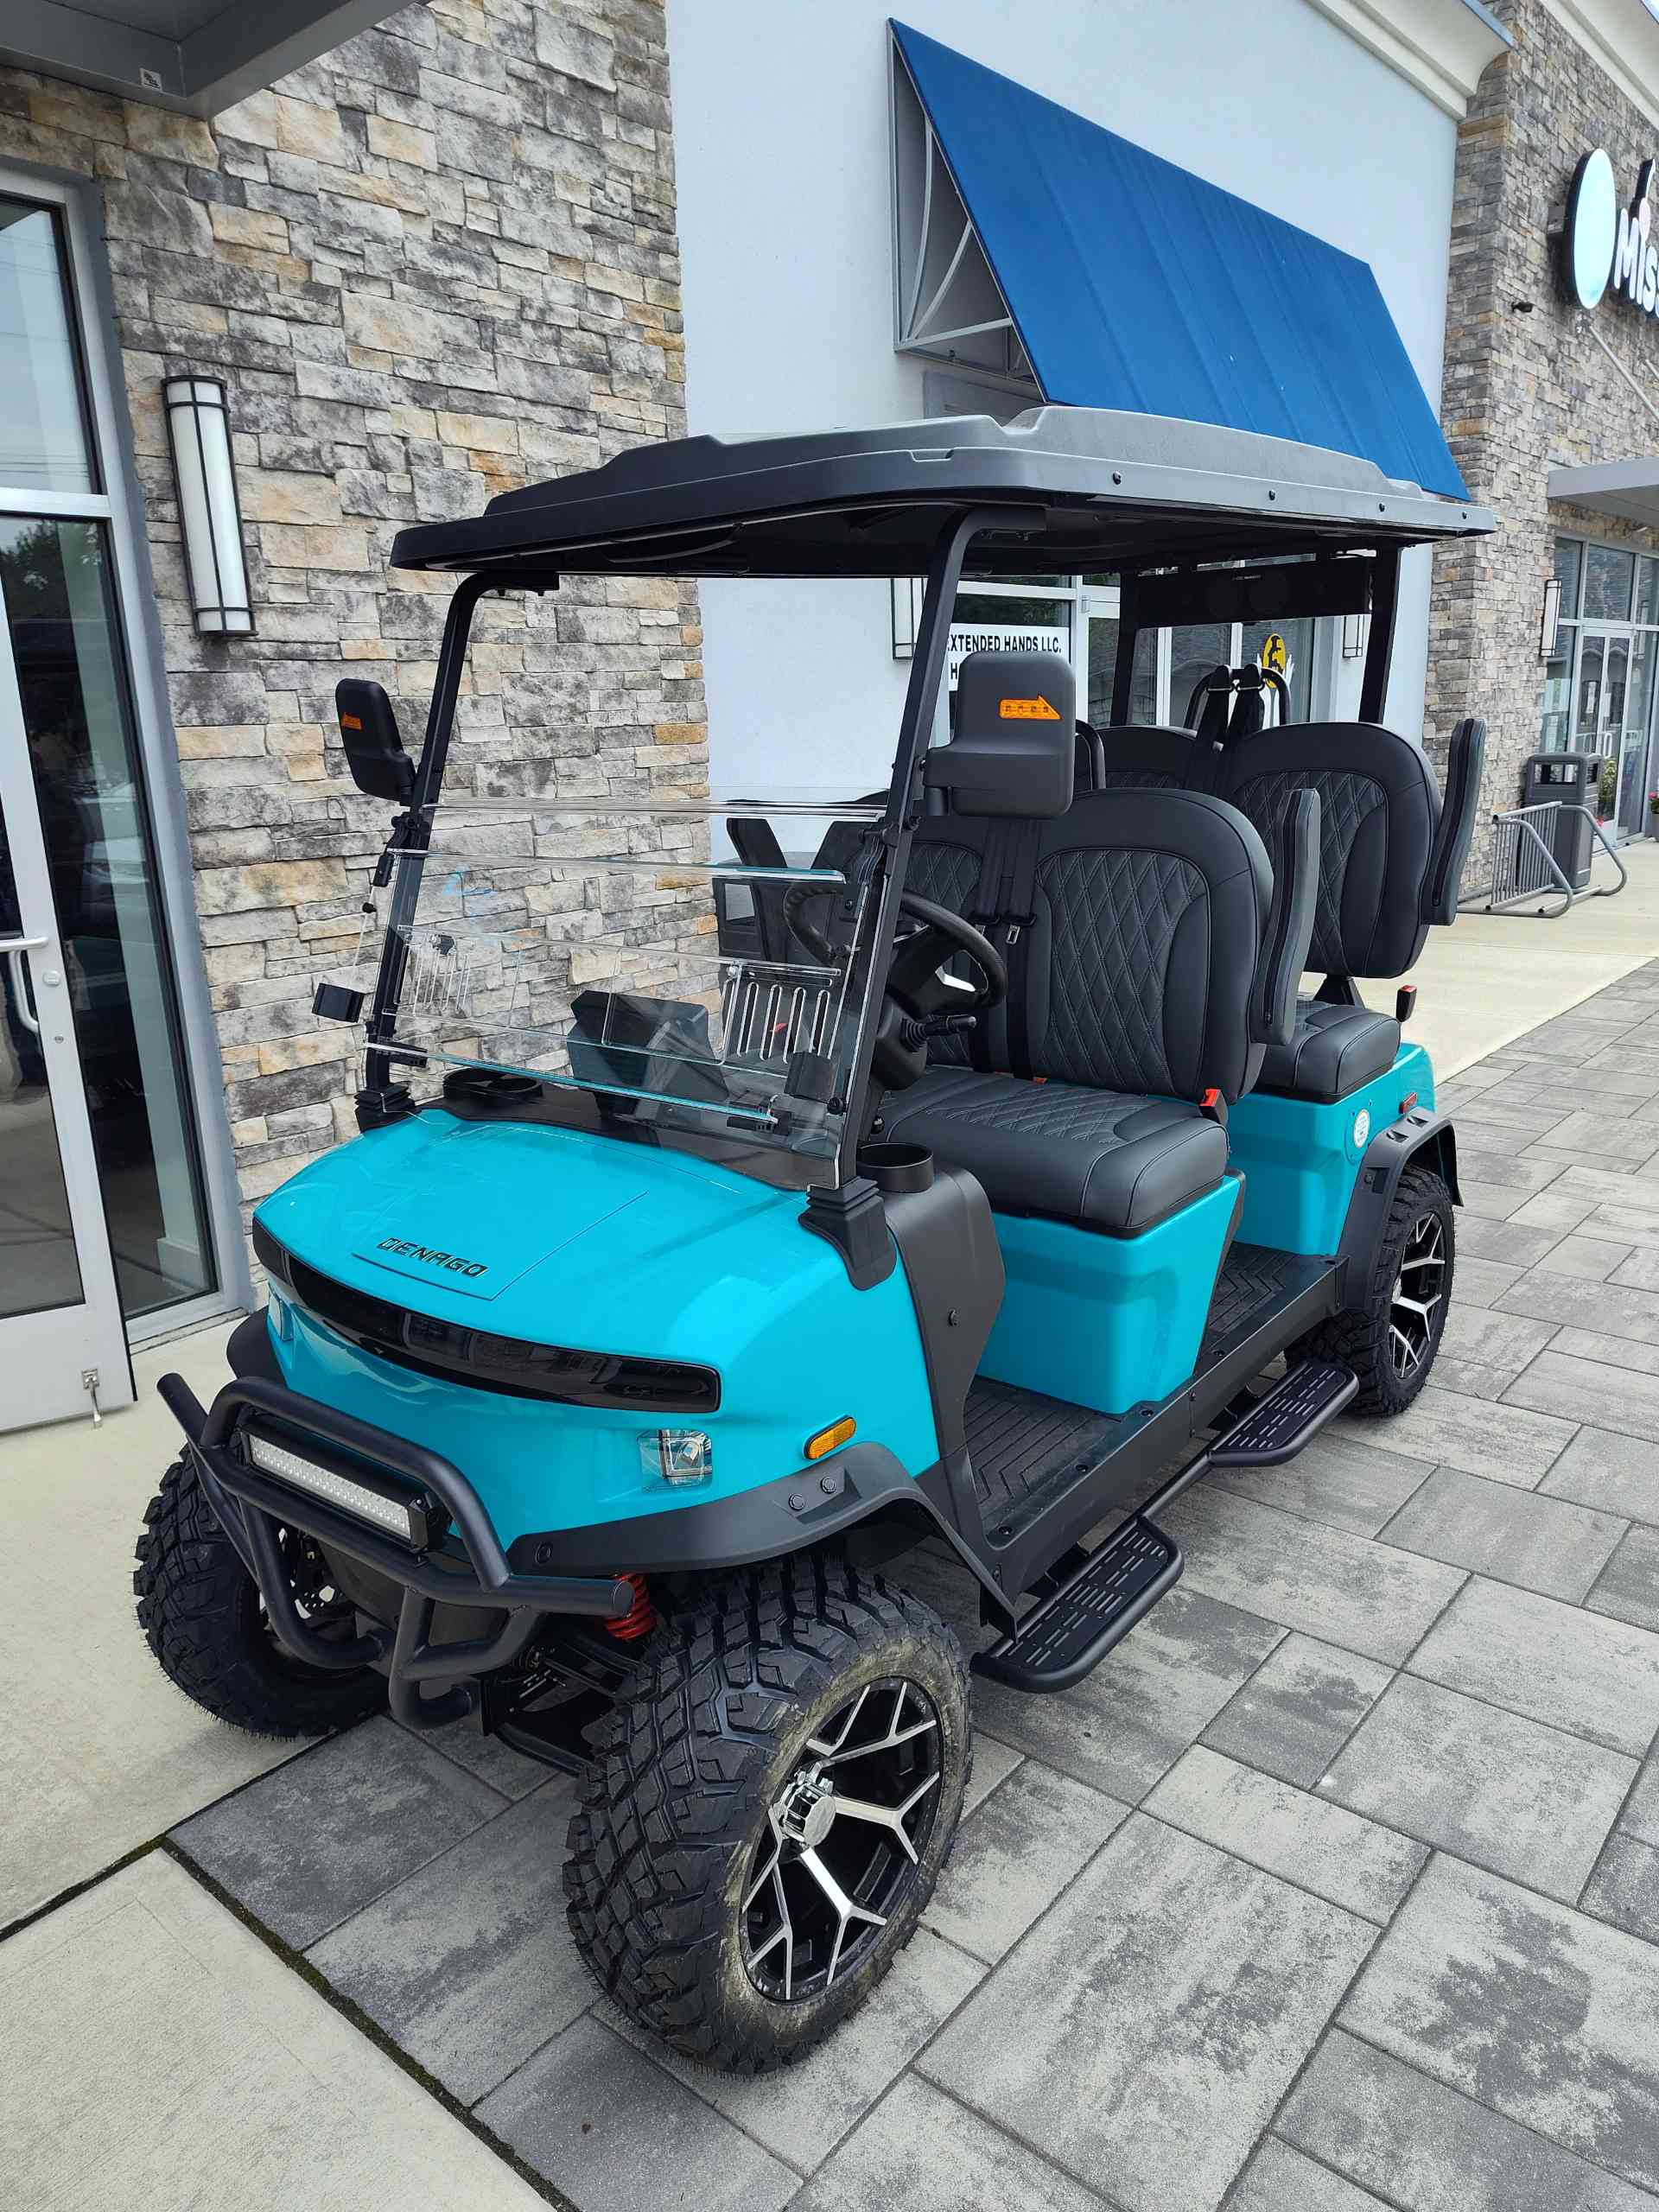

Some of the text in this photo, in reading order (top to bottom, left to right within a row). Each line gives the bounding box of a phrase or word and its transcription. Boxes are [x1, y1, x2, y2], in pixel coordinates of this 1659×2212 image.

[947, 634, 1001, 652] XTENDED
[1004, 635, 1039, 652] HANDS
[377, 1237, 489, 1278] DENAGO
